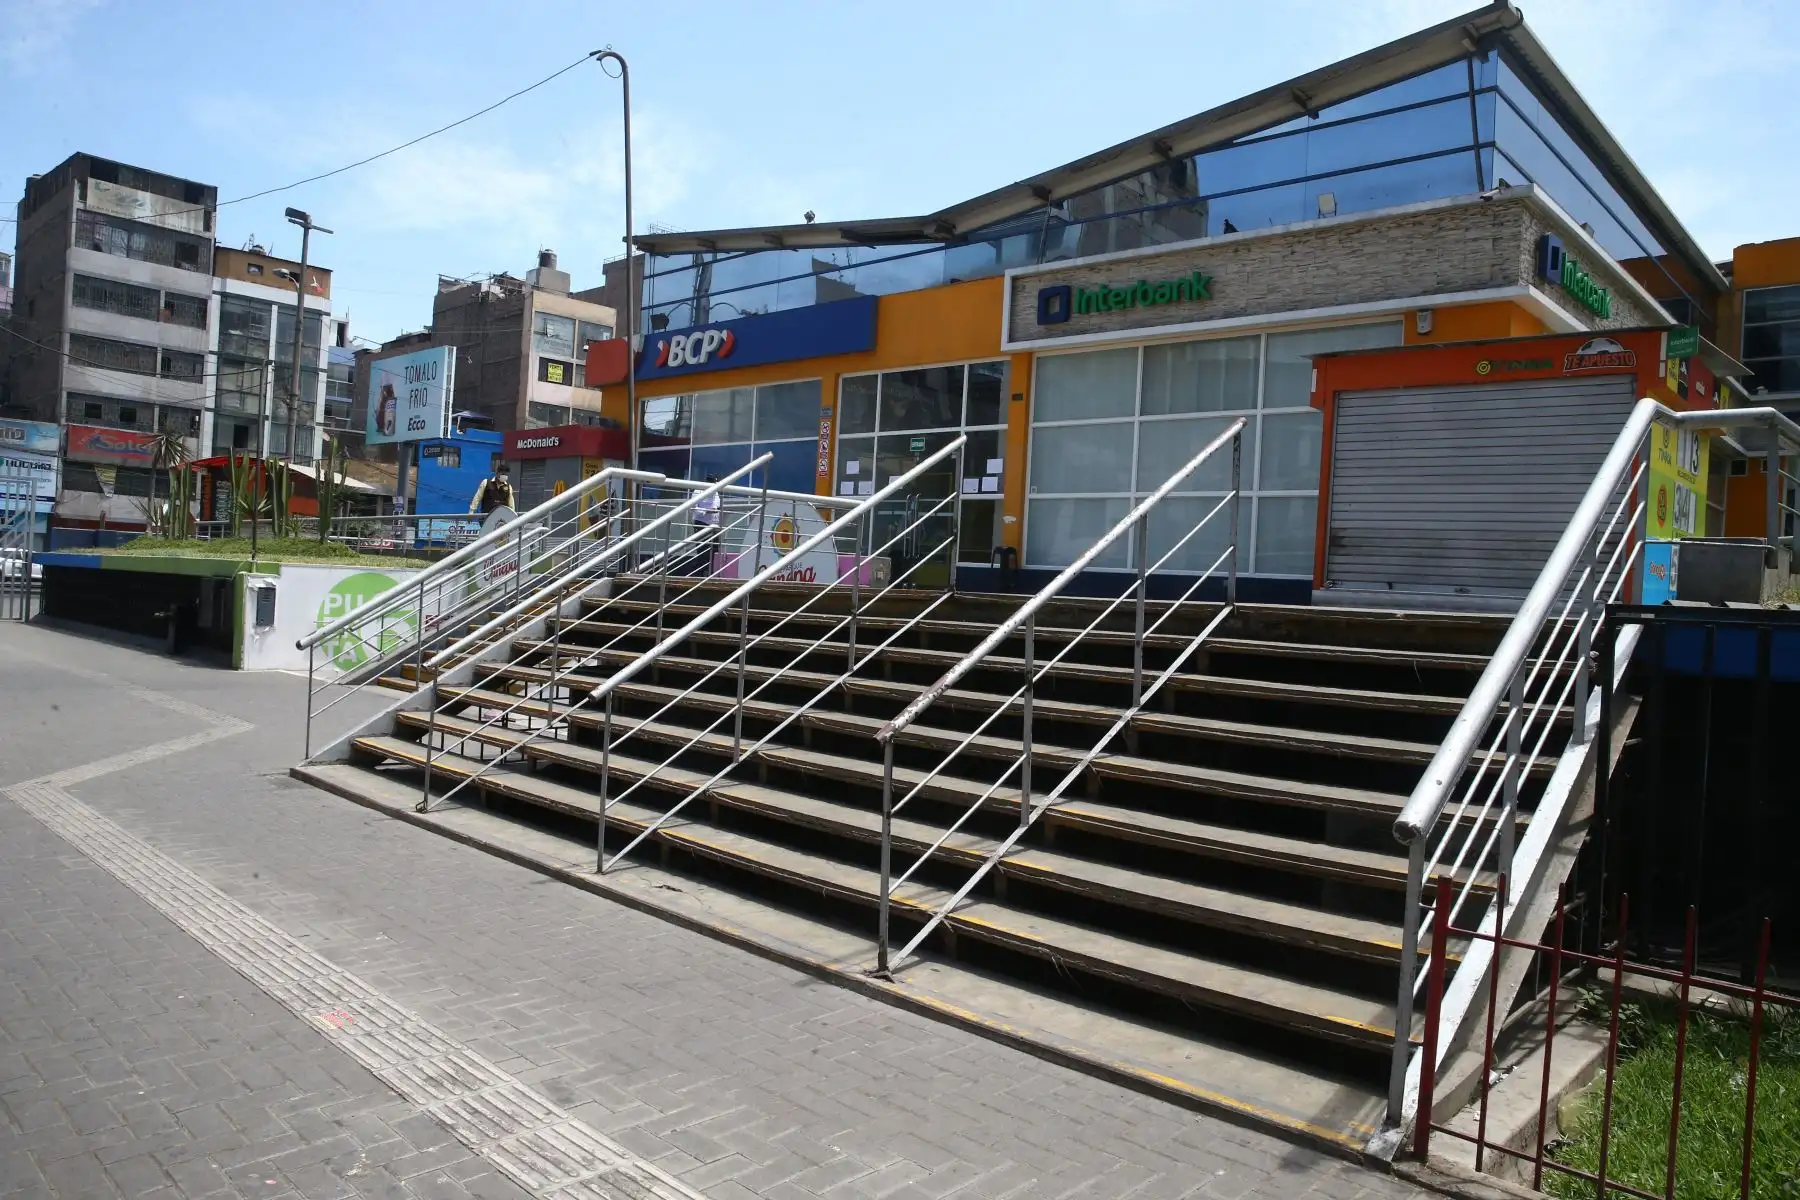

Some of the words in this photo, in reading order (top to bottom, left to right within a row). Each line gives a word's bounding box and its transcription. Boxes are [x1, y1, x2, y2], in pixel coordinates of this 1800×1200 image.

[1073, 271, 1213, 314] Interbank
[1562, 251, 1613, 320] Interbank
[668, 329, 721, 367] BCP
[1566, 354, 1580, 369] TE
[1583, 352, 1633, 367] APUESTO
[517, 436, 559, 449] McDonald's
